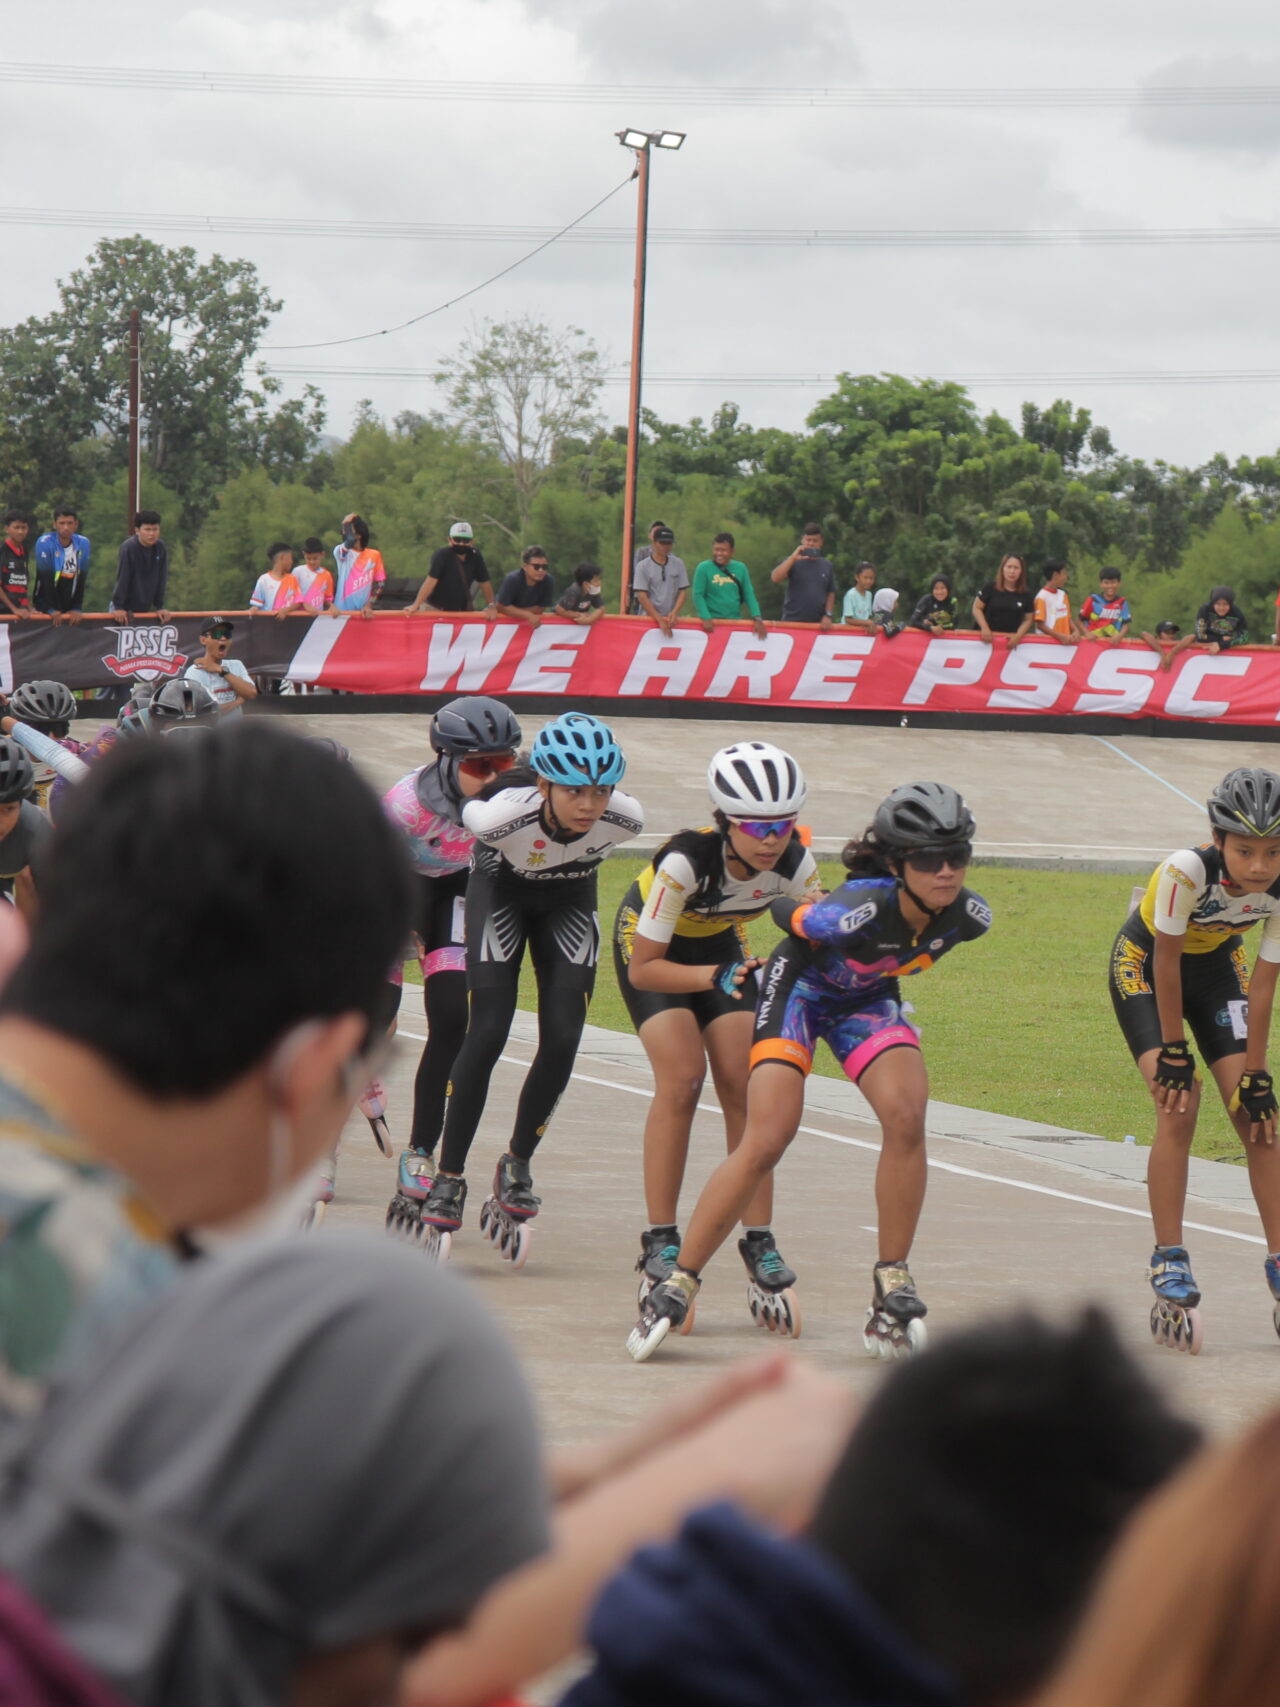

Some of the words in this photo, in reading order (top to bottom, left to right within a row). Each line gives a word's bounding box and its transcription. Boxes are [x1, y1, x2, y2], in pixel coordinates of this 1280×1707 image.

[119, 627, 177, 660] PSSC
[420, 622, 590, 695] WE
[618, 627, 876, 703] ARE
[902, 637, 1252, 718] PSSC
[844, 904, 874, 929] TFS
[968, 902, 992, 922] TFS
